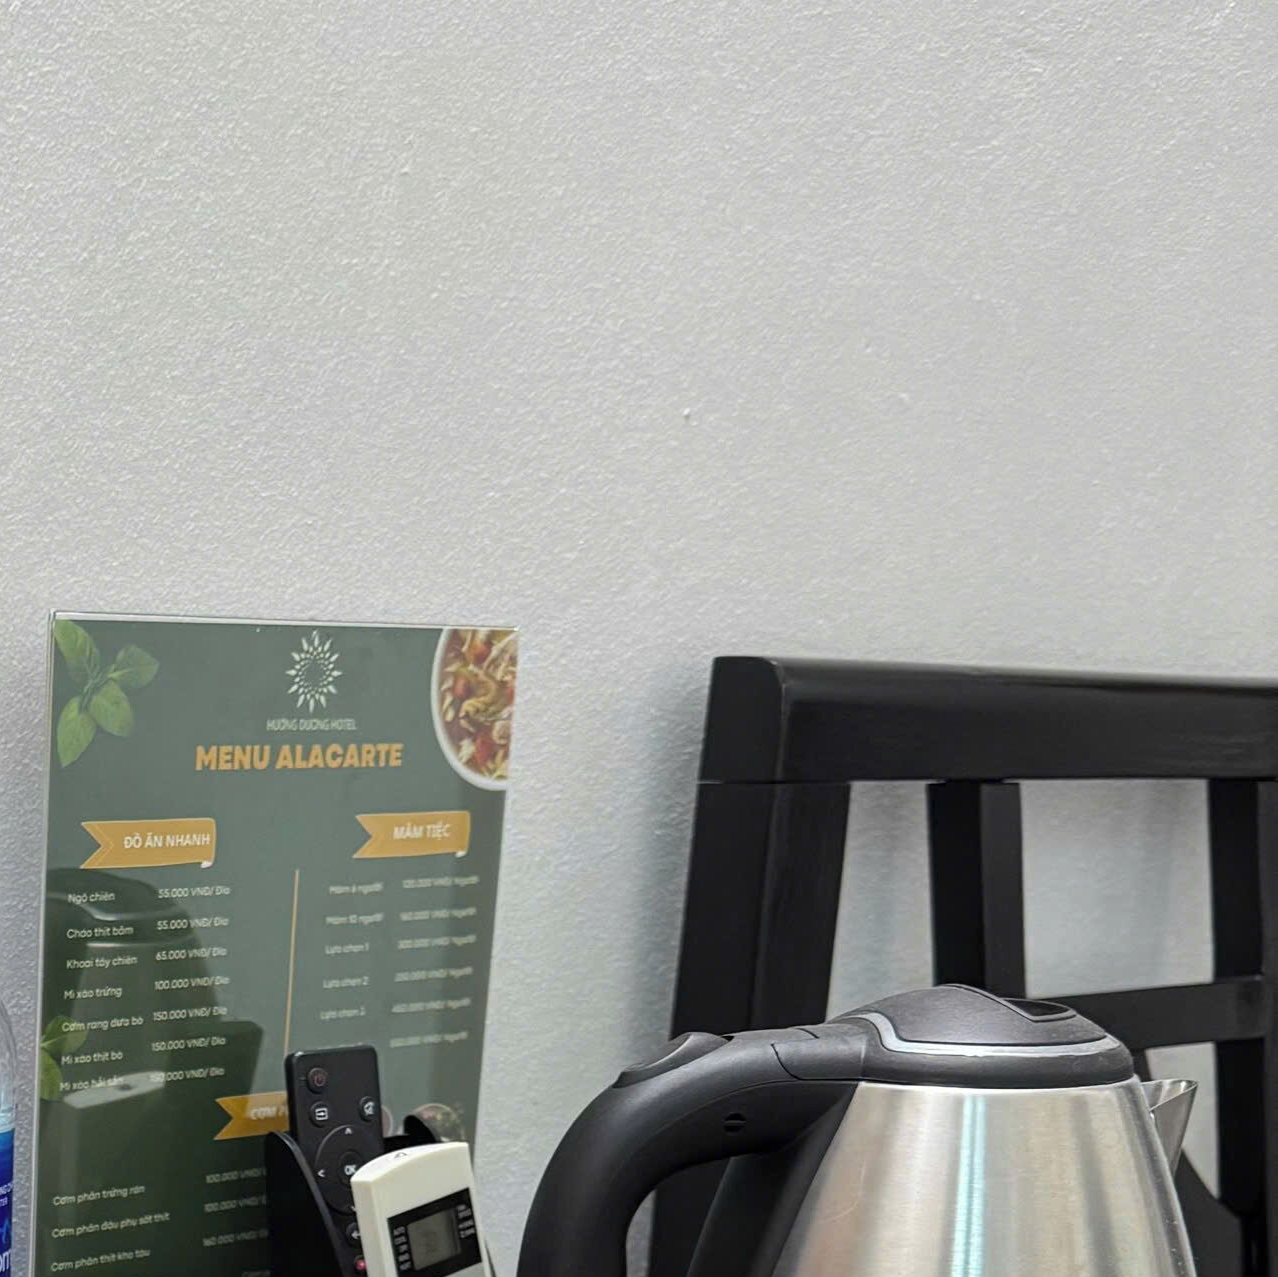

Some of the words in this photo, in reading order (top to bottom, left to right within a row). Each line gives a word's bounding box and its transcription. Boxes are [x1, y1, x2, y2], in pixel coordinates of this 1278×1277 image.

[330, 718, 357, 731] HOTEL
[195, 744, 270, 771] MENU
[275, 743, 404, 769] ALACARTE
[123, 832, 143, 849] ĐỒ
[144, 832, 163, 849] ĂN
[165, 833, 211, 848] NHANH
[157, 887, 189, 899] 55.000
[156, 919, 189, 931] 55.000
[66, 959, 94, 969] Khoai
[154, 978, 189, 991] 100.000
[87, 1020, 109, 1031] rang
